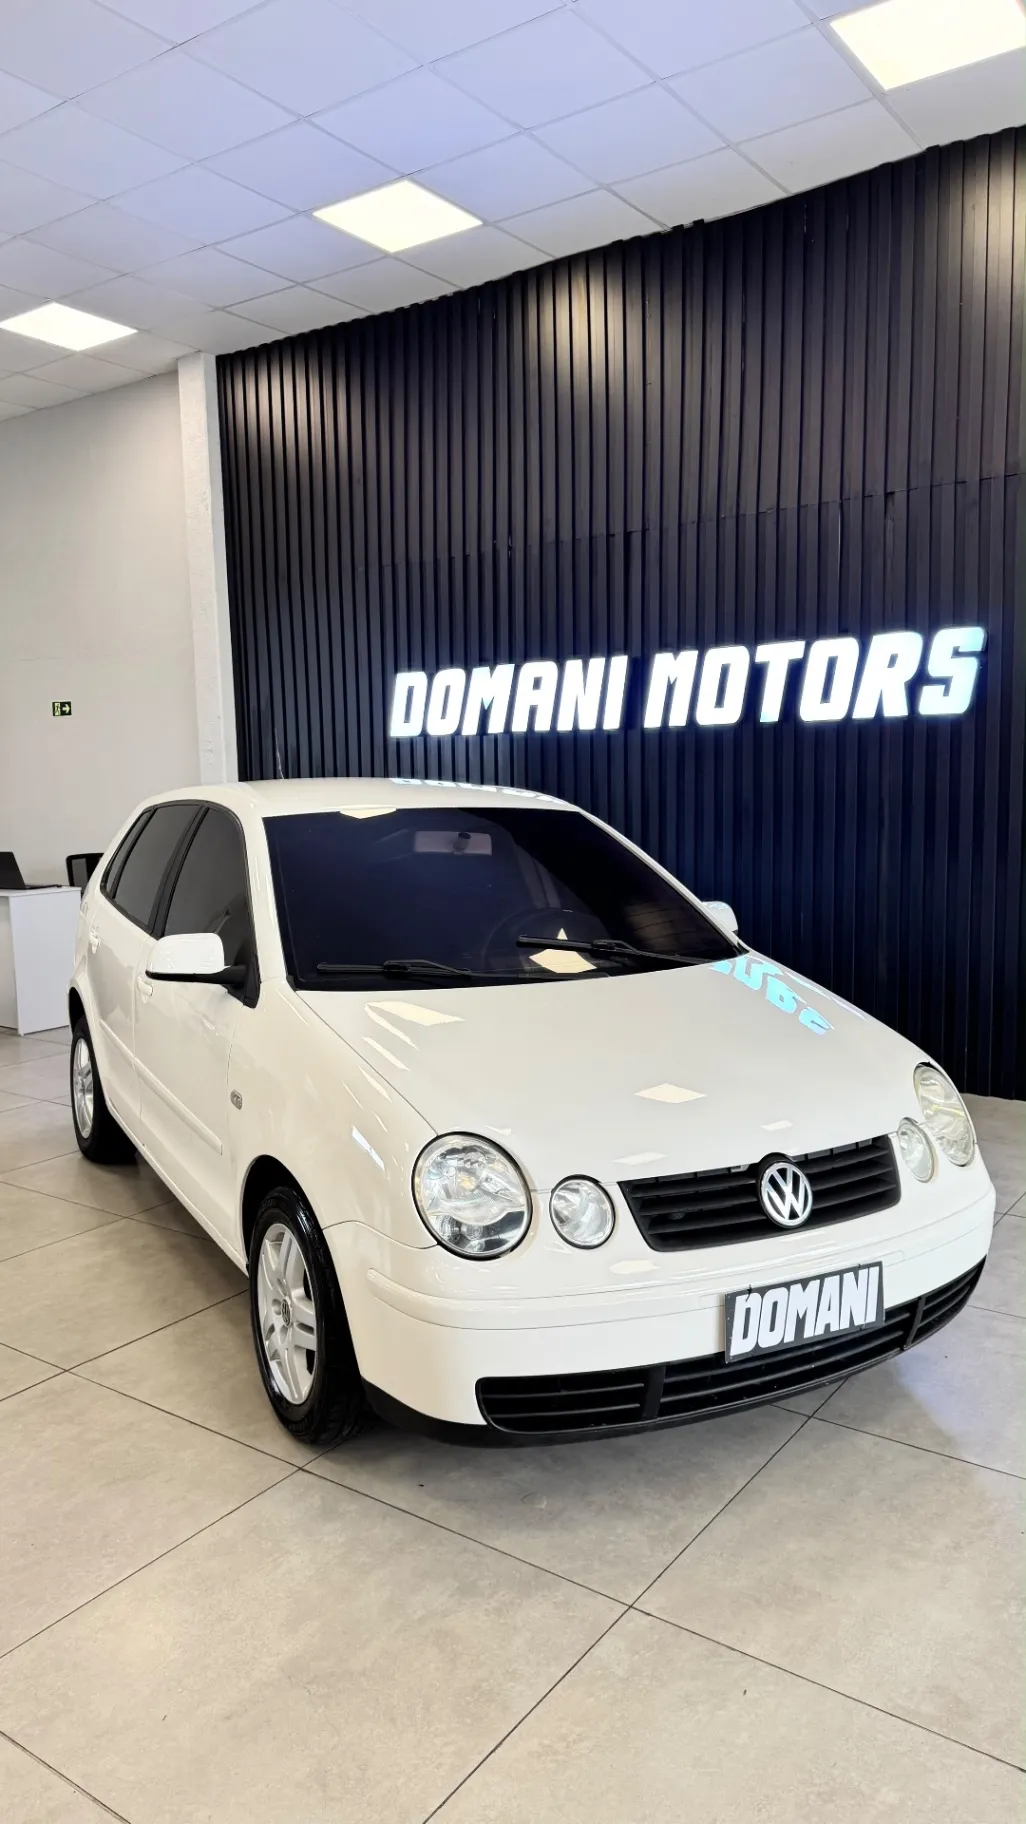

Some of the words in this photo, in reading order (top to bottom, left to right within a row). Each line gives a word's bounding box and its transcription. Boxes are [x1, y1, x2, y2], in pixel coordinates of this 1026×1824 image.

[389, 655, 629, 738] DOMANI
[643, 626, 986, 730] MOTORS
[730, 1266, 880, 1356] DOMANI
